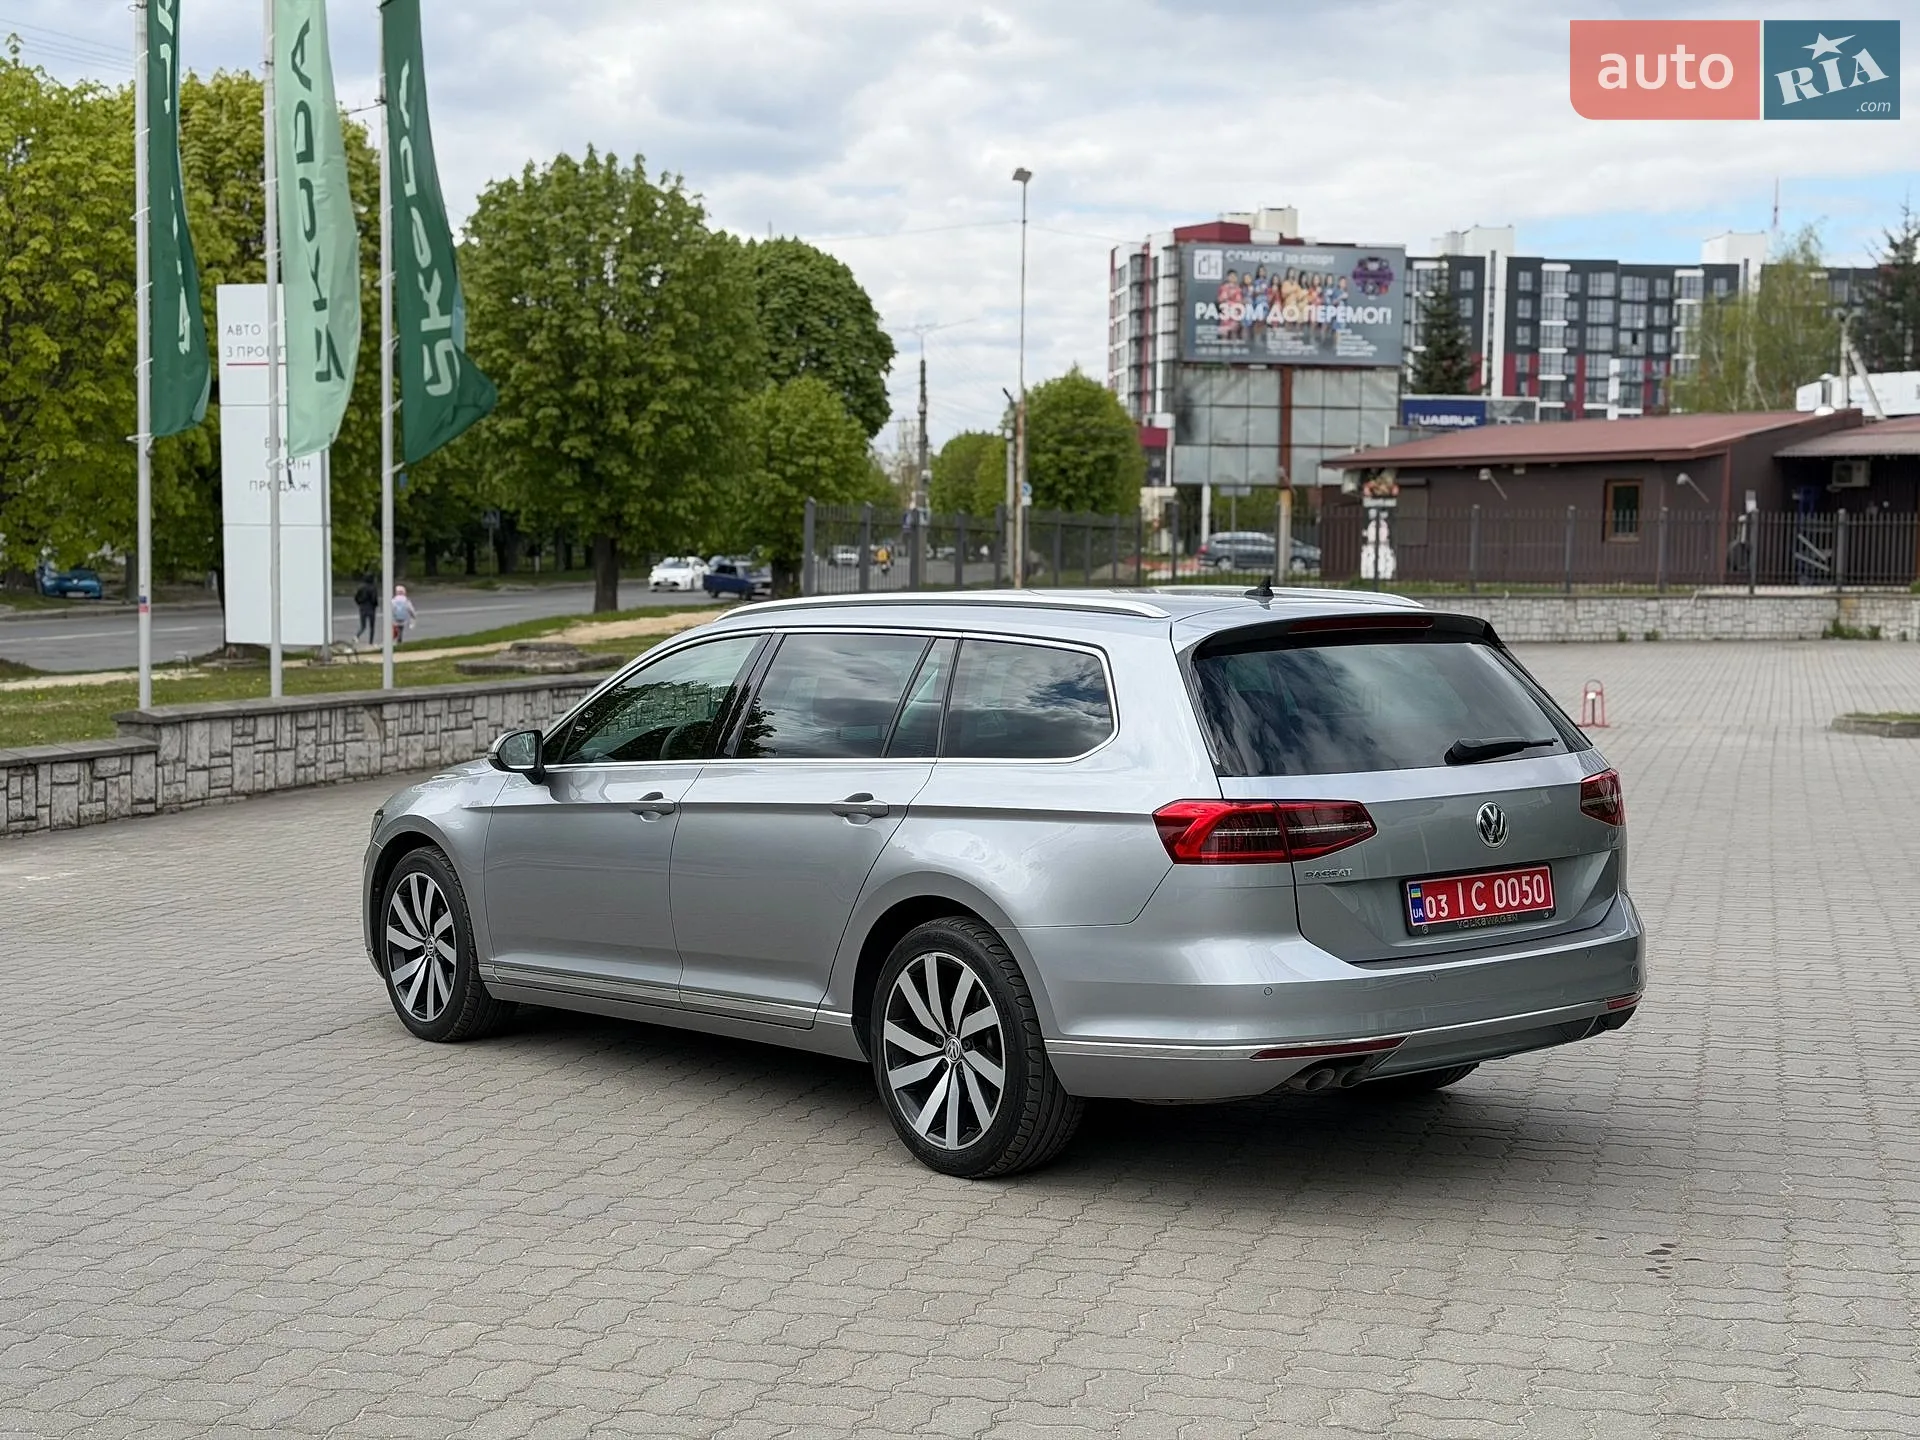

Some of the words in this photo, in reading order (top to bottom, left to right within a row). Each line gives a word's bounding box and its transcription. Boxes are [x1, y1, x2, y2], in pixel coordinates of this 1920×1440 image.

[1195, 302, 1265, 321] РАЗОМ
[1266, 304, 1300, 324] ДО
[227, 324, 261, 336] АВТО
[1425, 894, 1449, 919] 03
[1493, 874, 1546, 909] 0050
[1413, 908, 1424, 919] UA
[1456, 913, 1518, 929] VOLKSWAGEN
